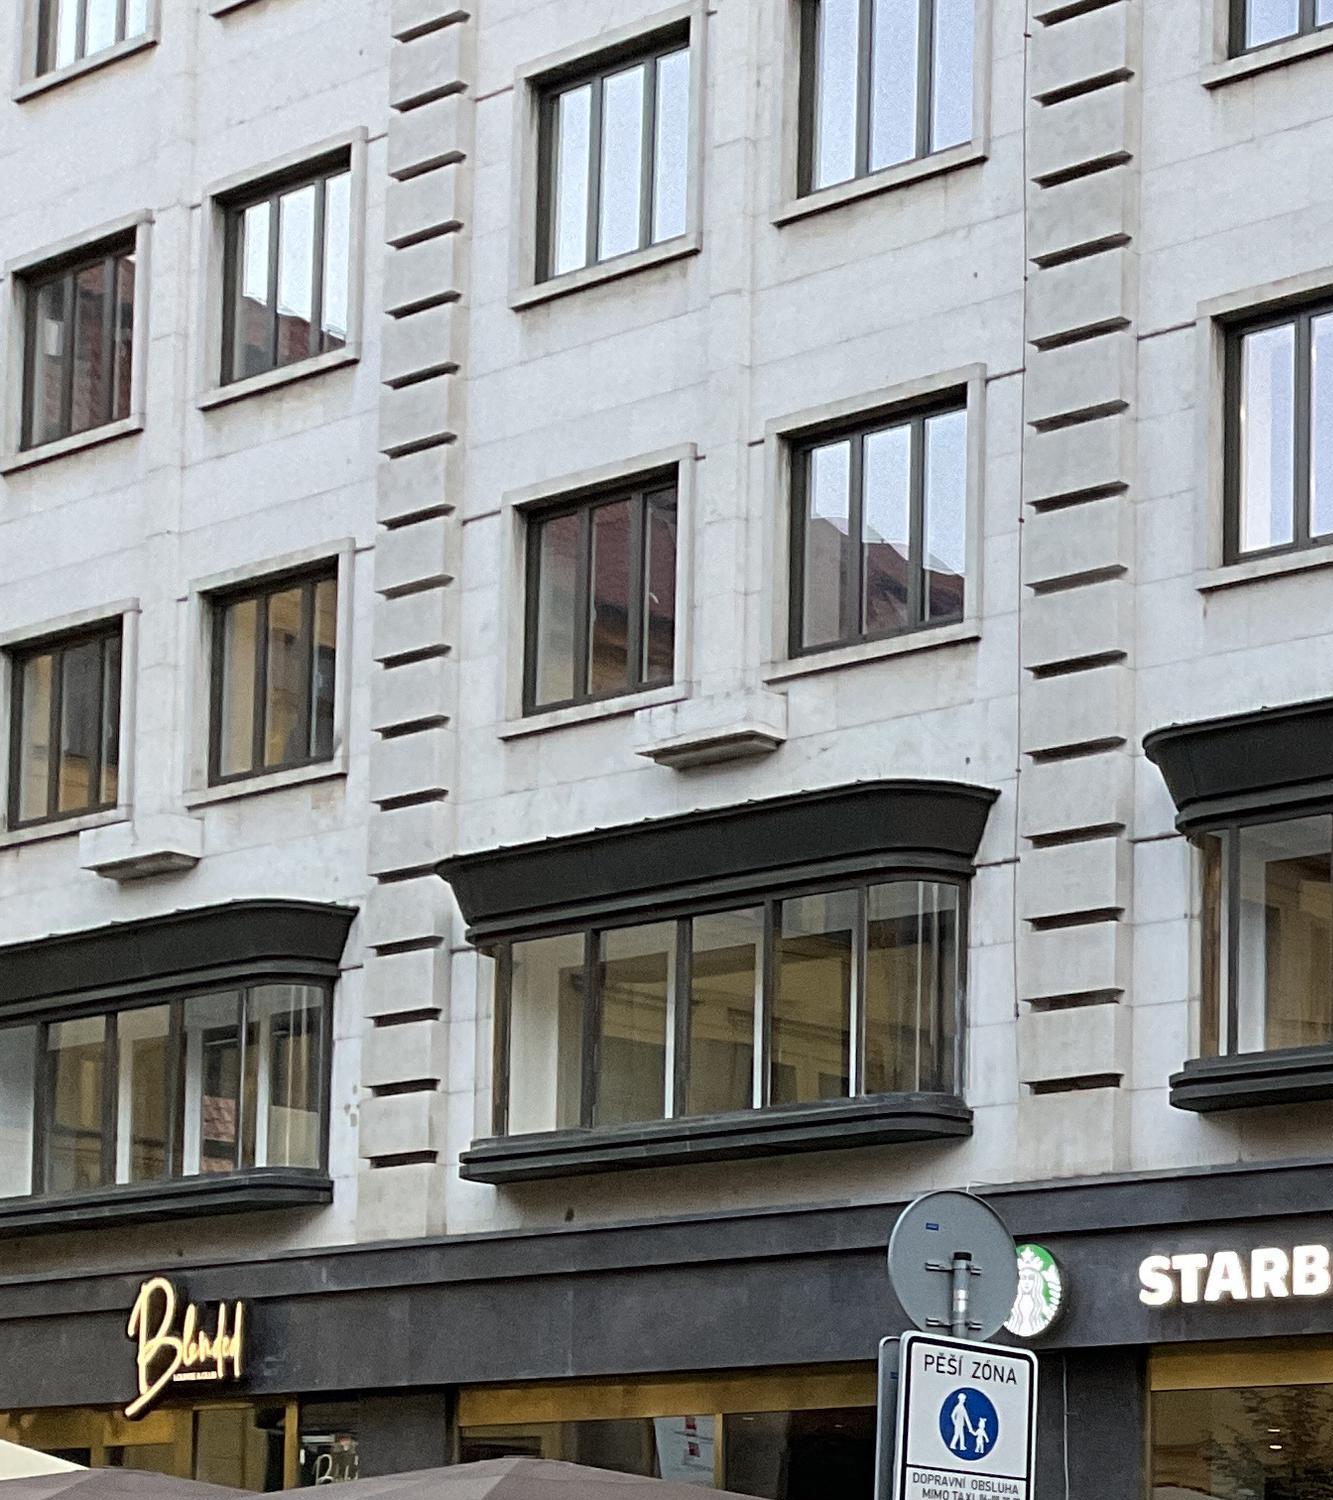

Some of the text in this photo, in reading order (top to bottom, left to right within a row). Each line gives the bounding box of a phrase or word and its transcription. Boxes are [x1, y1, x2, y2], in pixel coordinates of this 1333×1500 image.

[924, 1353, 1017, 1385] PĚŠÍ ZÓNA
[912, 1472, 1019, 1494] DOPRAVNÍ OBSLUHA
[922, 1488, 949, 1500] MIMO
